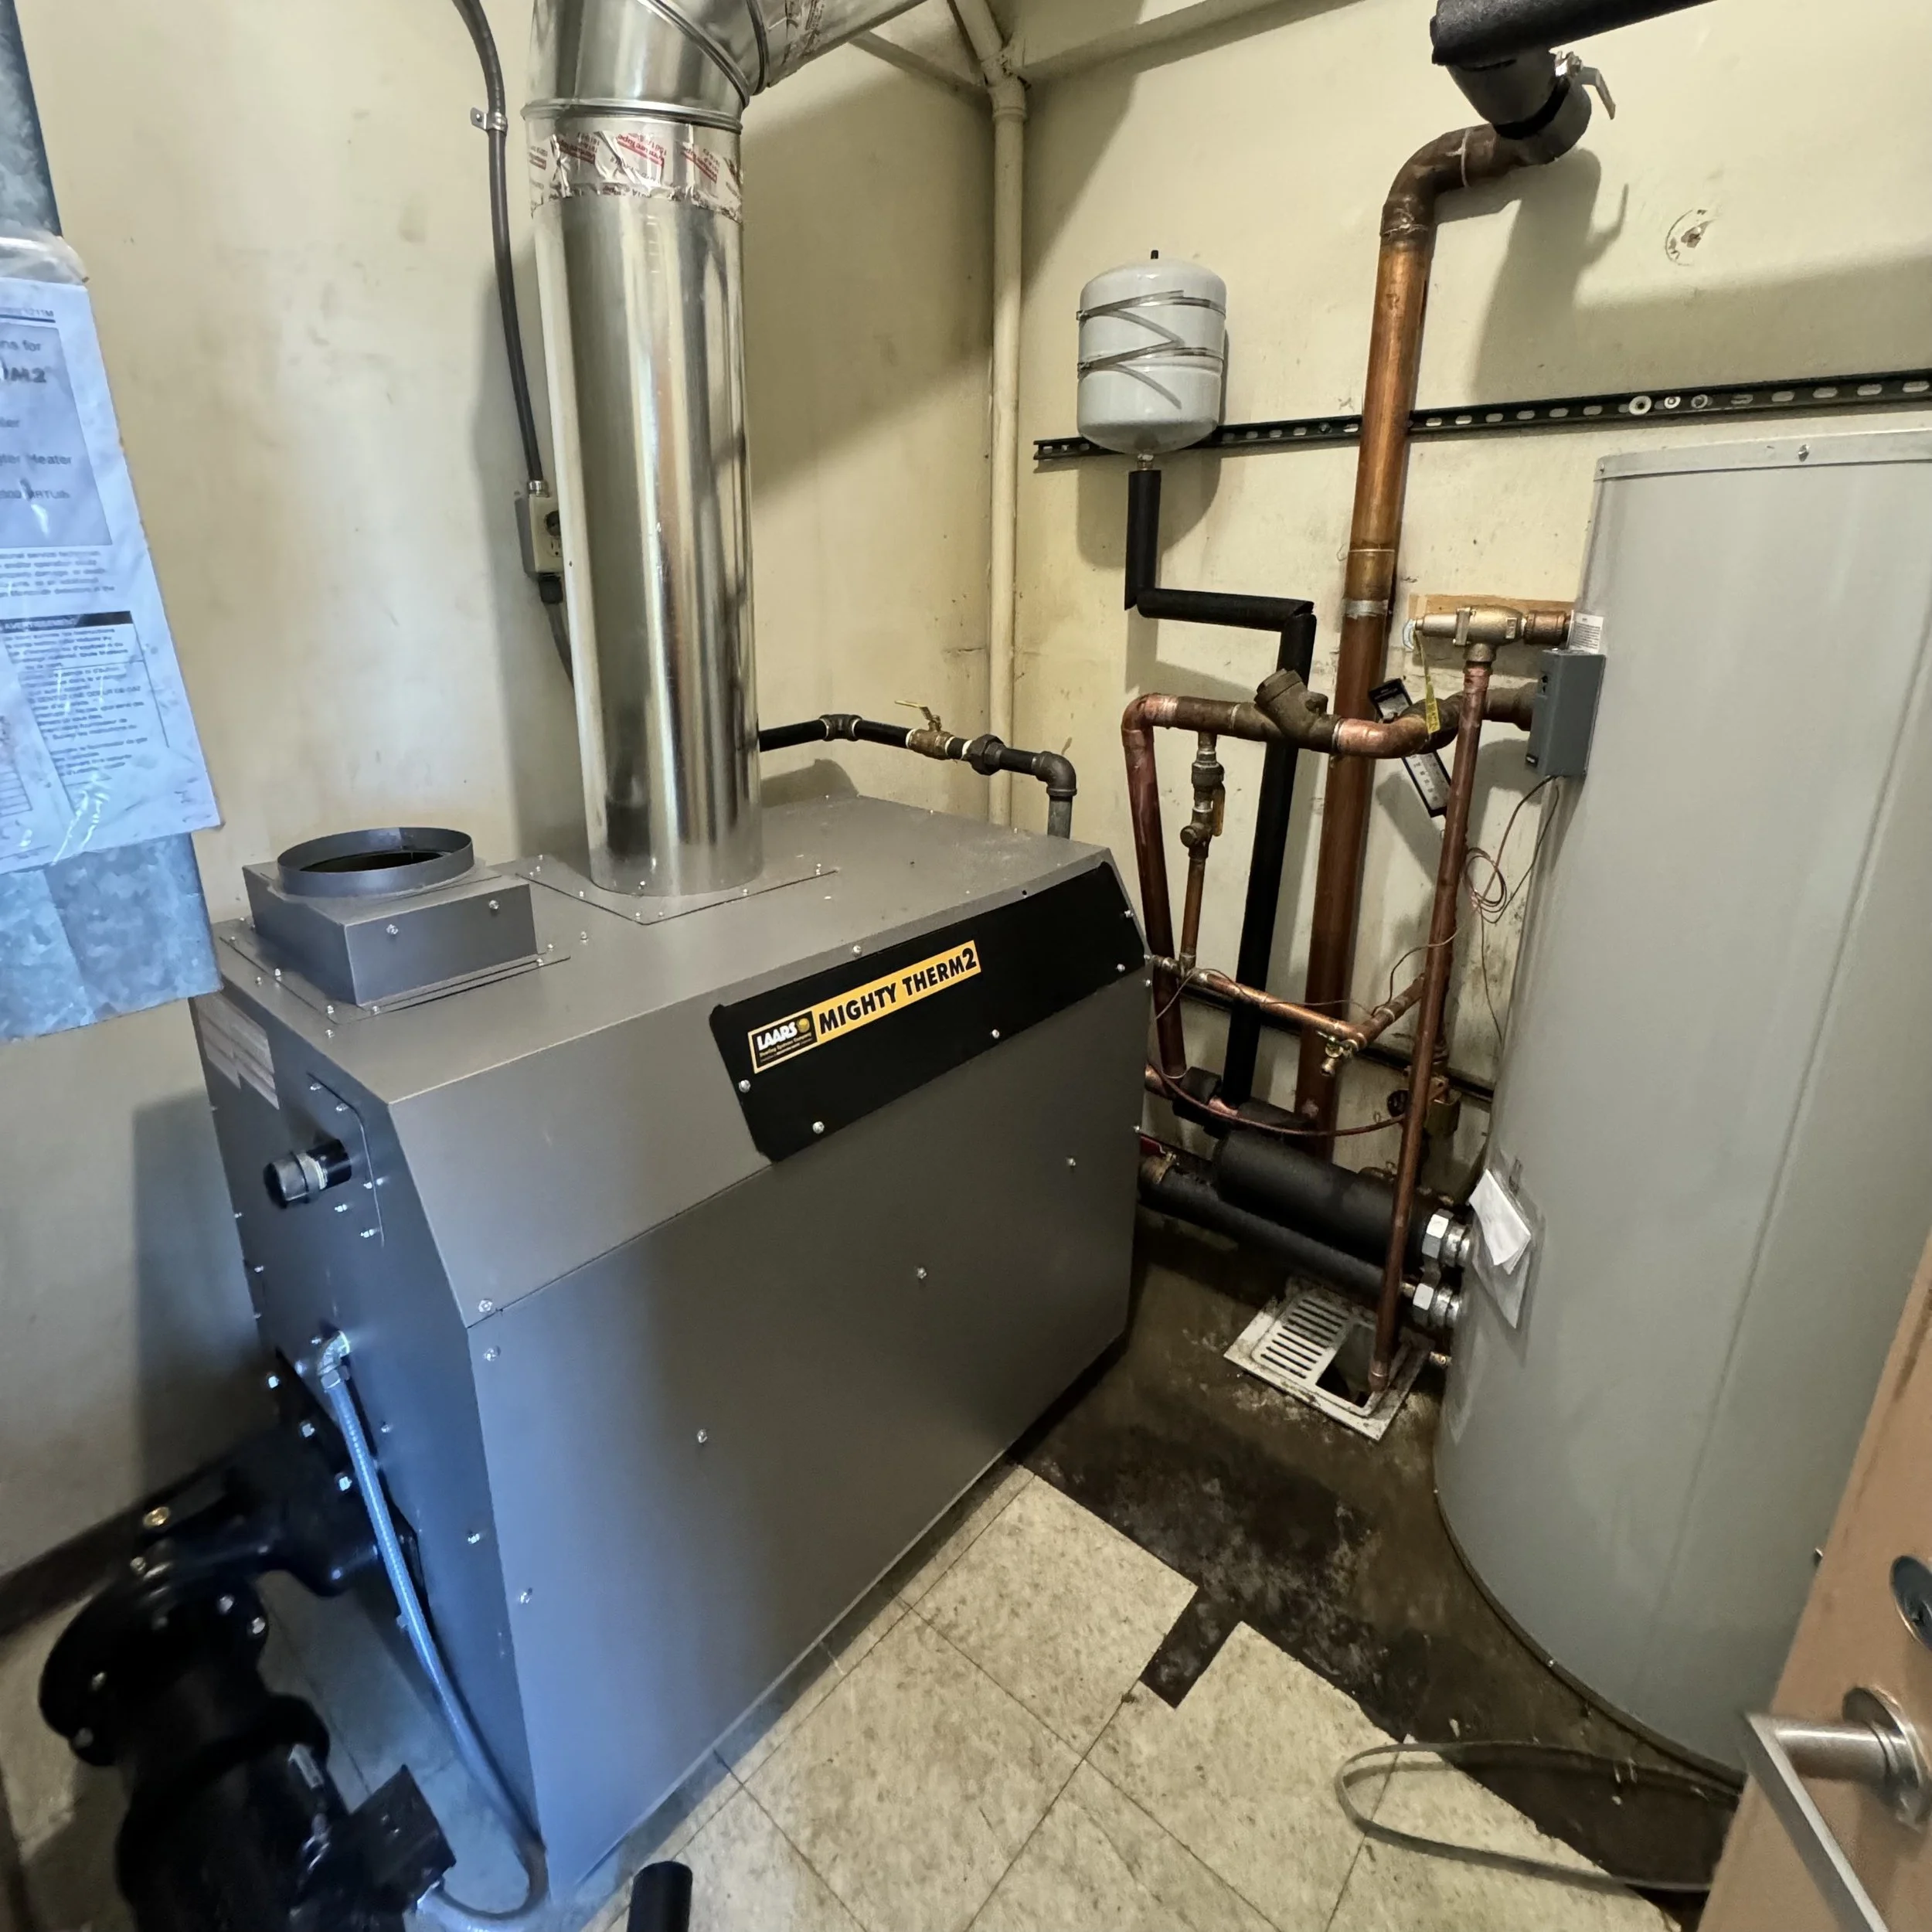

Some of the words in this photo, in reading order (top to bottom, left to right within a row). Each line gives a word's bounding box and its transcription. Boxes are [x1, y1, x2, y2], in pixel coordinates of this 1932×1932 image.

[819, 983, 897, 1035] MIGHTY
[902, 947, 978, 996] THERM2
[757, 1022, 798, 1050] LAARS
